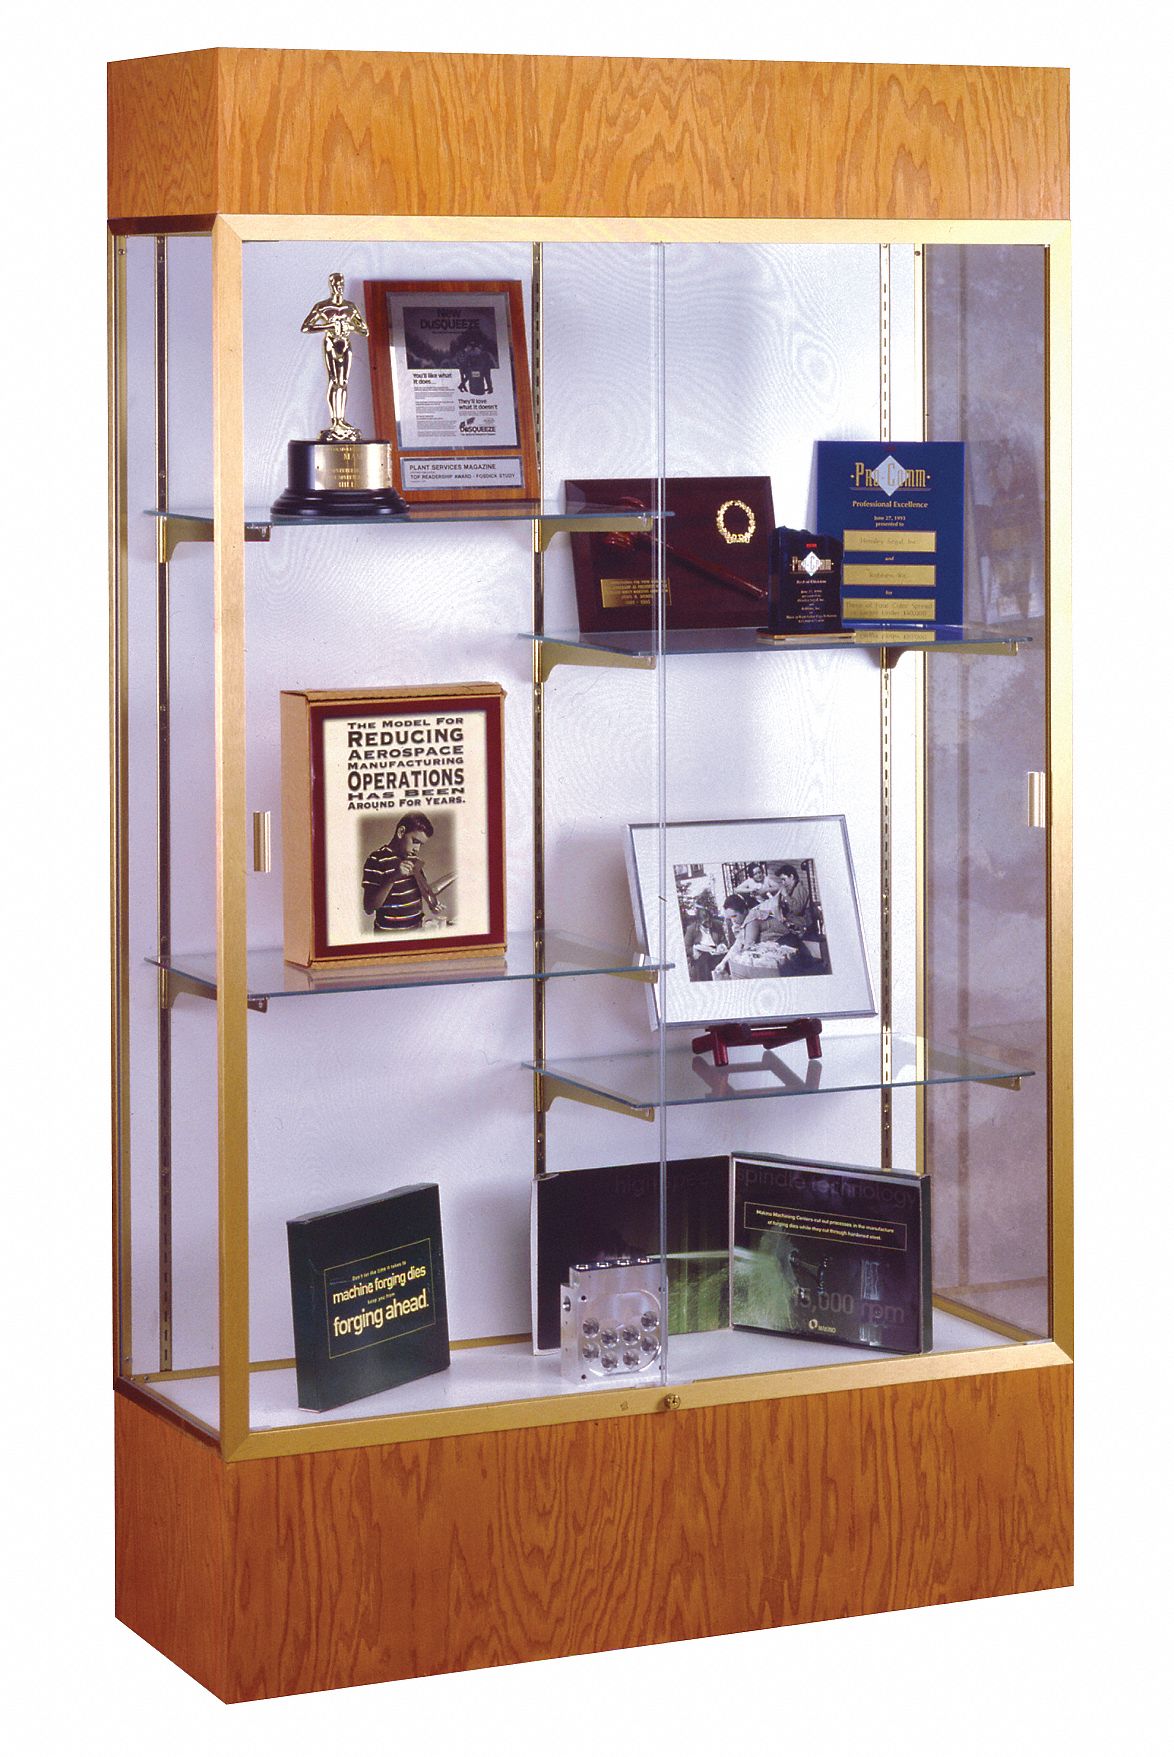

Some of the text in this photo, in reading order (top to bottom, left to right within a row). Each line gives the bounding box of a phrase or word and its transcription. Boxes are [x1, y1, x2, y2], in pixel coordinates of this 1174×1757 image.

[852, 500, 892, 508] Professional
[347, 717, 464, 730] THE MODEL FOR
[347, 728, 464, 748] REDUCING
[348, 745, 464, 760] AEROSPACE
[347, 757, 464, 771] MANUFACTURING
[347, 768, 465, 792] OPERATIONS
[348, 787, 465, 801] HAS BEEN
[347, 796, 466, 811] AROUND FOR YEARS.
[332, 1265, 426, 1304] machine forging dies
[333, 1288, 430, 1336] forging ahead.
